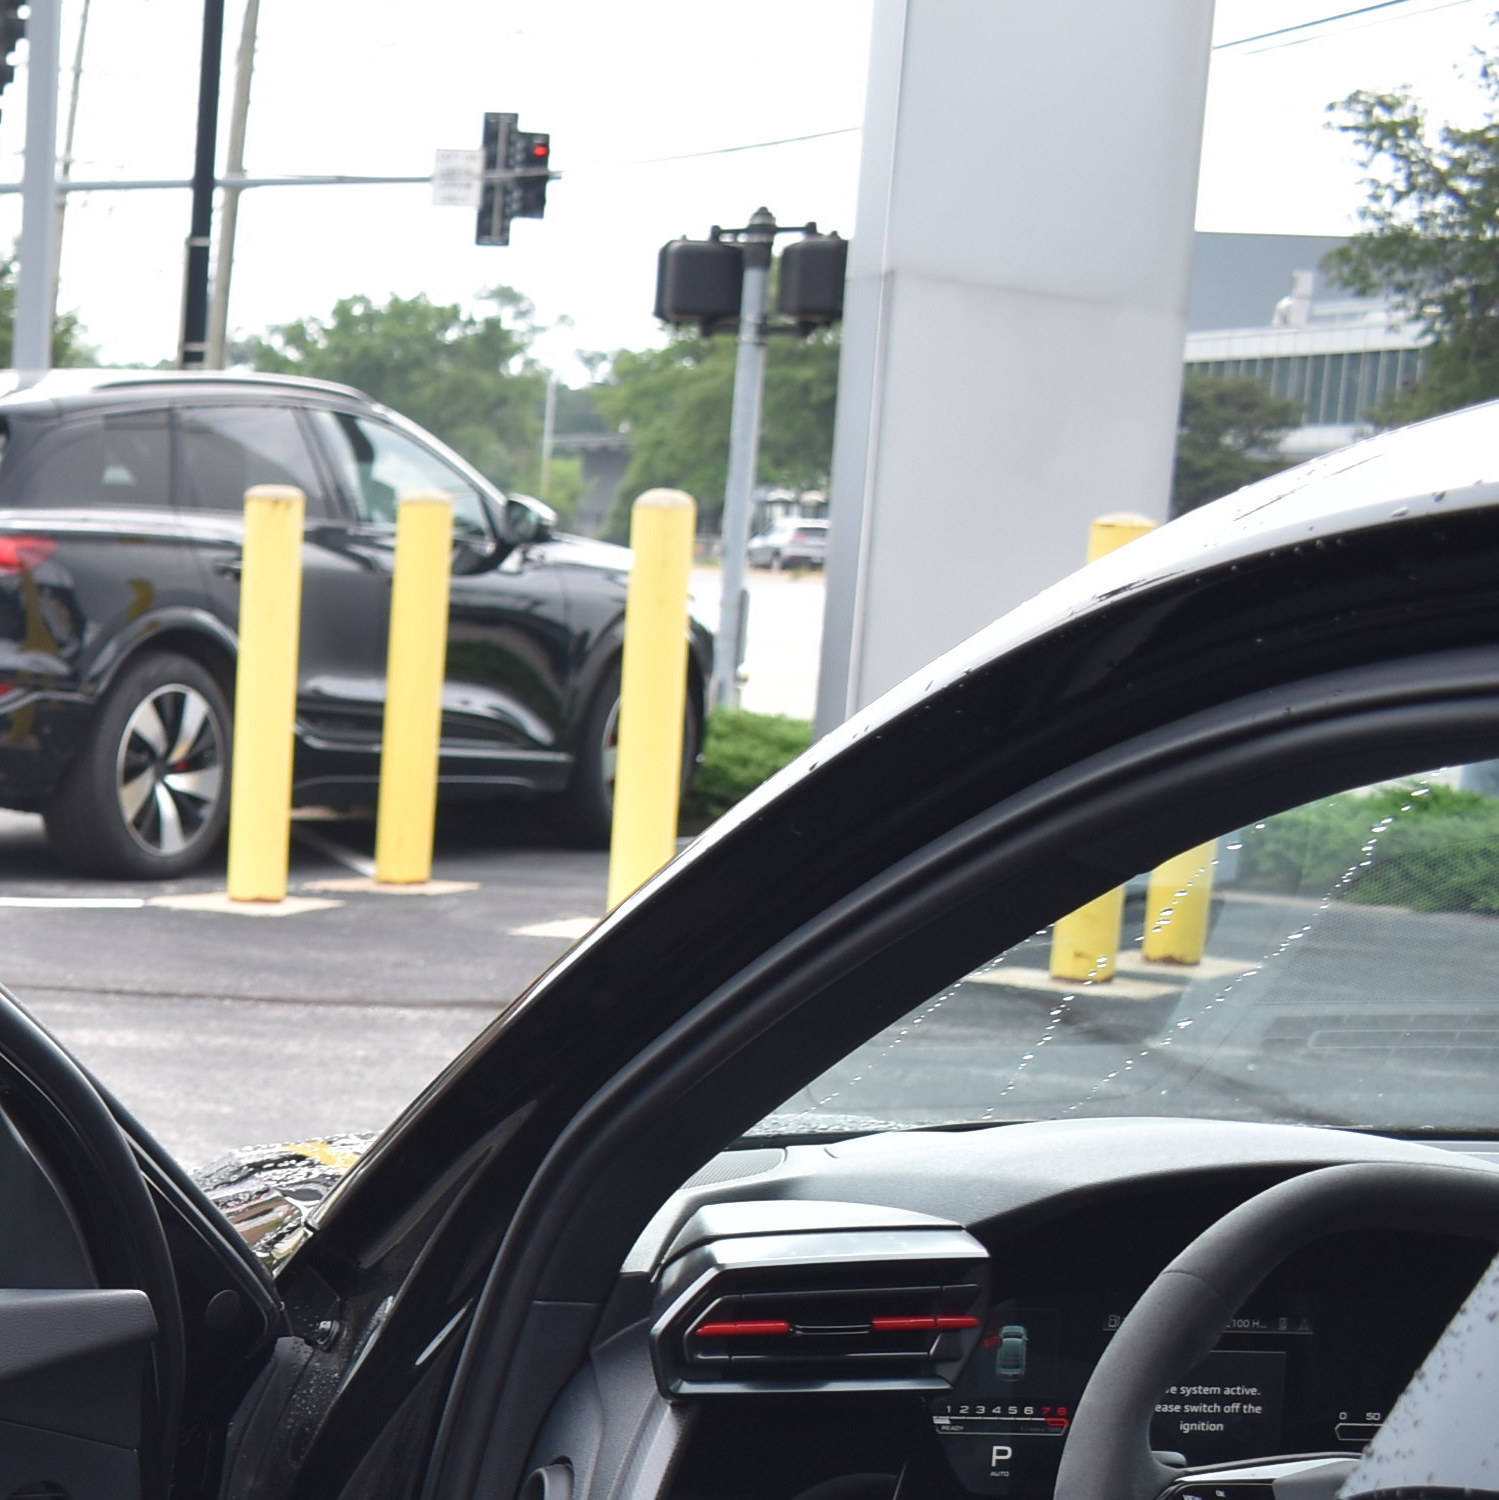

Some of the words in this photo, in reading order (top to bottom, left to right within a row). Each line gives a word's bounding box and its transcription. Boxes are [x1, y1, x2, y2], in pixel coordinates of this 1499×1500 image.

[1165, 1386, 1177, 1394] e
[1179, 1385, 1221, 1397] system
[1223, 1385, 1261, 1395] active.
[946, 1405, 951, 1413] 1
[959, 1405, 970, 1414] 2
[975, 1405, 986, 1414] 3
[991, 1406, 1001, 1414] 4
[1008, 1406, 1018, 1414] 5
[1024, 1406, 1034, 1415] 6
[1042, 1407, 1051, 1415] 7
[1056, 1407, 1068, 1416] 8
[1155, 1404, 1181, 1413] ease
[1183, 1402, 1221, 1413] switch
[1223, 1402, 1242, 1413] off
[1242, 1403, 1262, 1414] the
[1338, 1412, 1347, 1420] 0
[1365, 1412, 1381, 1421] 50
[1179, 1420, 1224, 1433] ignition
[991, 1445, 1012, 1467] P
